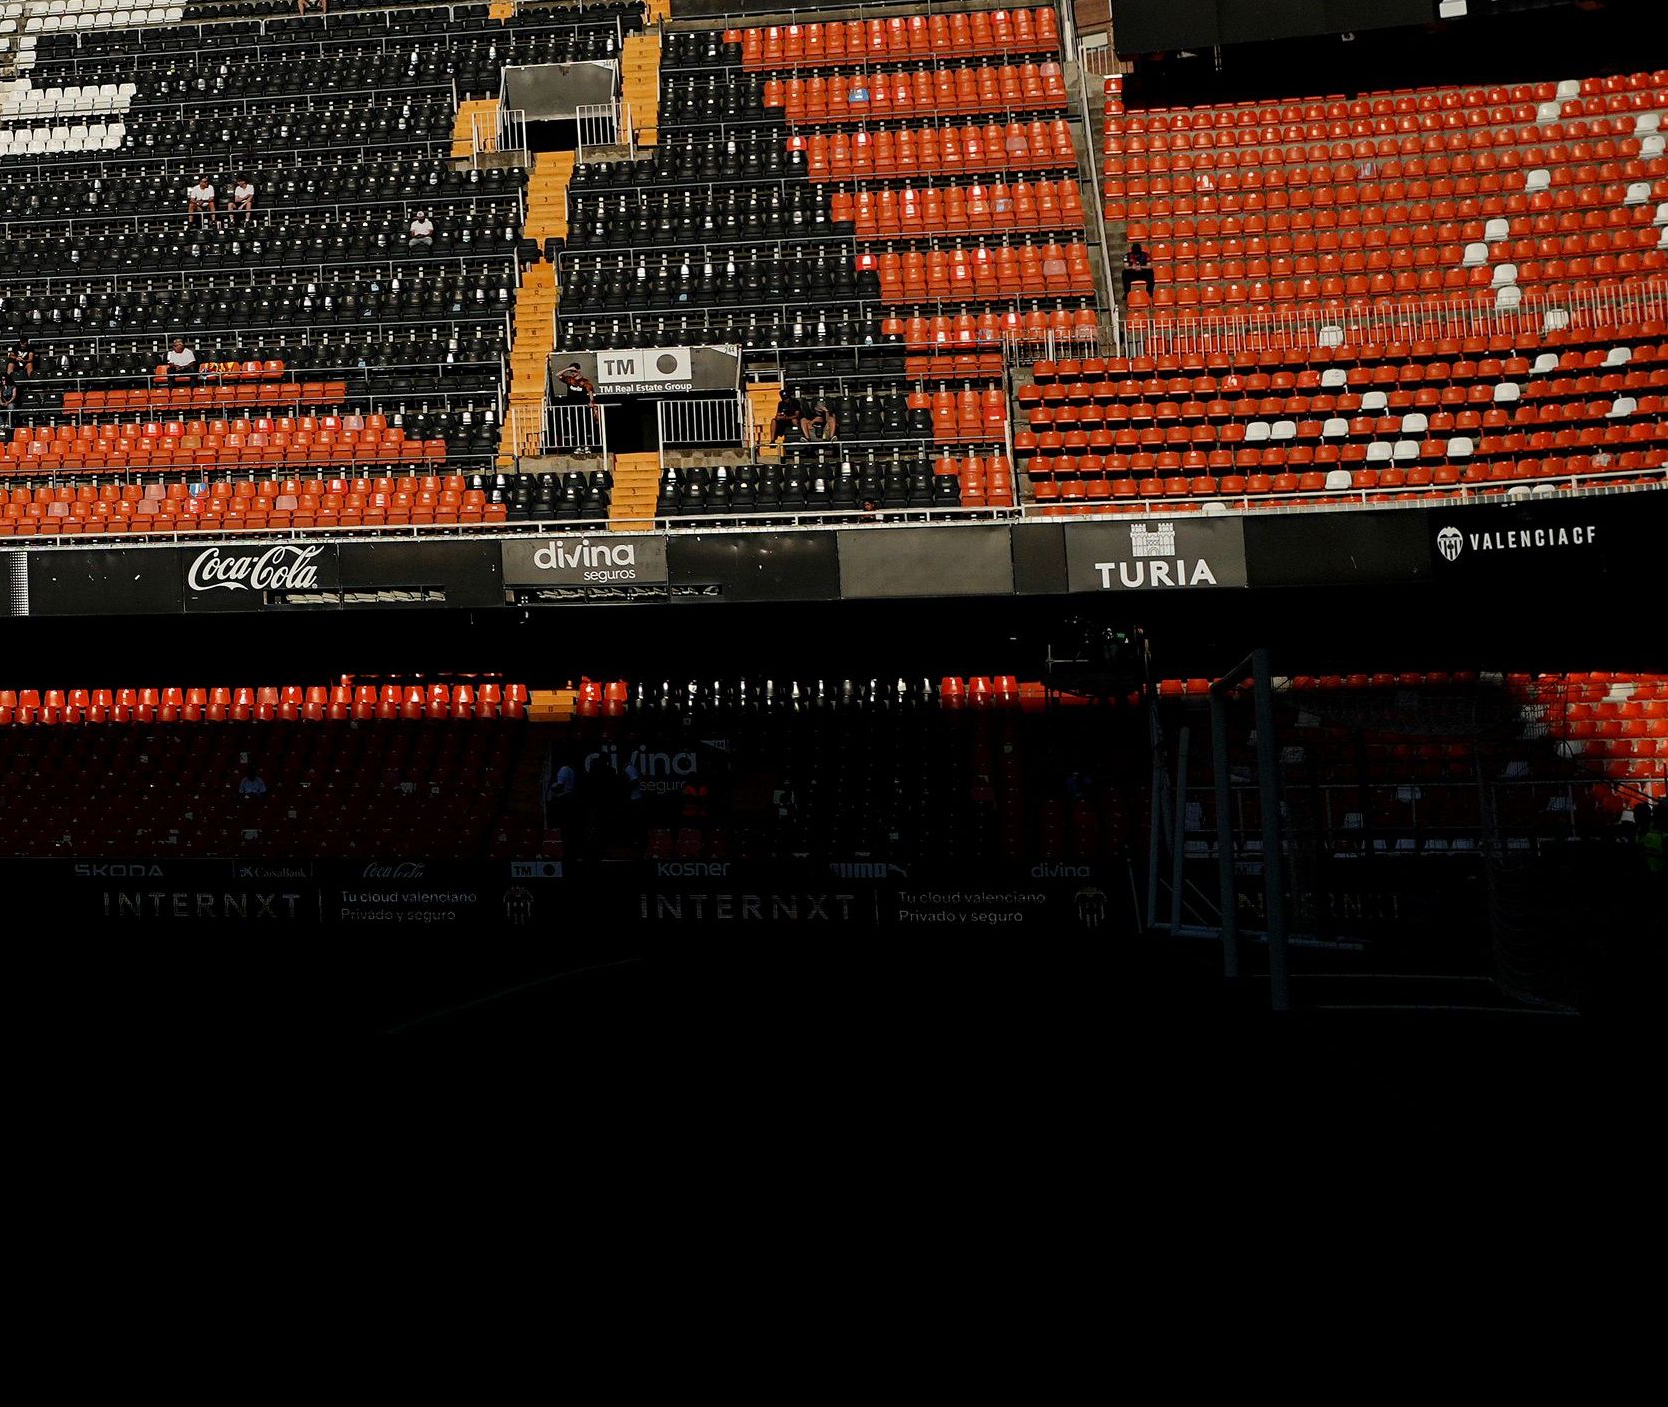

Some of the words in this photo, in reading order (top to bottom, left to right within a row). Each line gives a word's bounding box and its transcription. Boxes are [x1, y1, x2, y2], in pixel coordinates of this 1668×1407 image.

[604, 359, 635, 376] TM
[599, 385, 613, 393] TM
[615, 384, 634, 393] Real
[636, 383, 662, 392] Estate
[664, 382, 692, 393] Group
[534, 540, 635, 569] divina
[188, 545, 324, 592] Coca-Cola
[583, 568, 636, 583] seguros
[1096, 559, 1216, 588] TURIA
[74, 864, 165, 878] SKODA
[255, 865, 308, 879] CaixaBank
[515, 865, 533, 876] TM
[1031, 863, 1091, 879] divina
[102, 892, 301, 919] INTERNXT
[341, 891, 357, 904] Tu
[359, 891, 399, 904] cloud
[401, 891, 478, 904] valenciano
[897, 891, 917, 904] Tu
[919, 891, 961, 904] cloud
[962, 891, 1047, 904] valenciano
[340, 907, 394, 921] Privado
[406, 911, 456, 923] seguro
[638, 893, 855, 921] INTERNXT
[898, 909, 957, 923] Privado
[970, 912, 1024, 926] seguro
